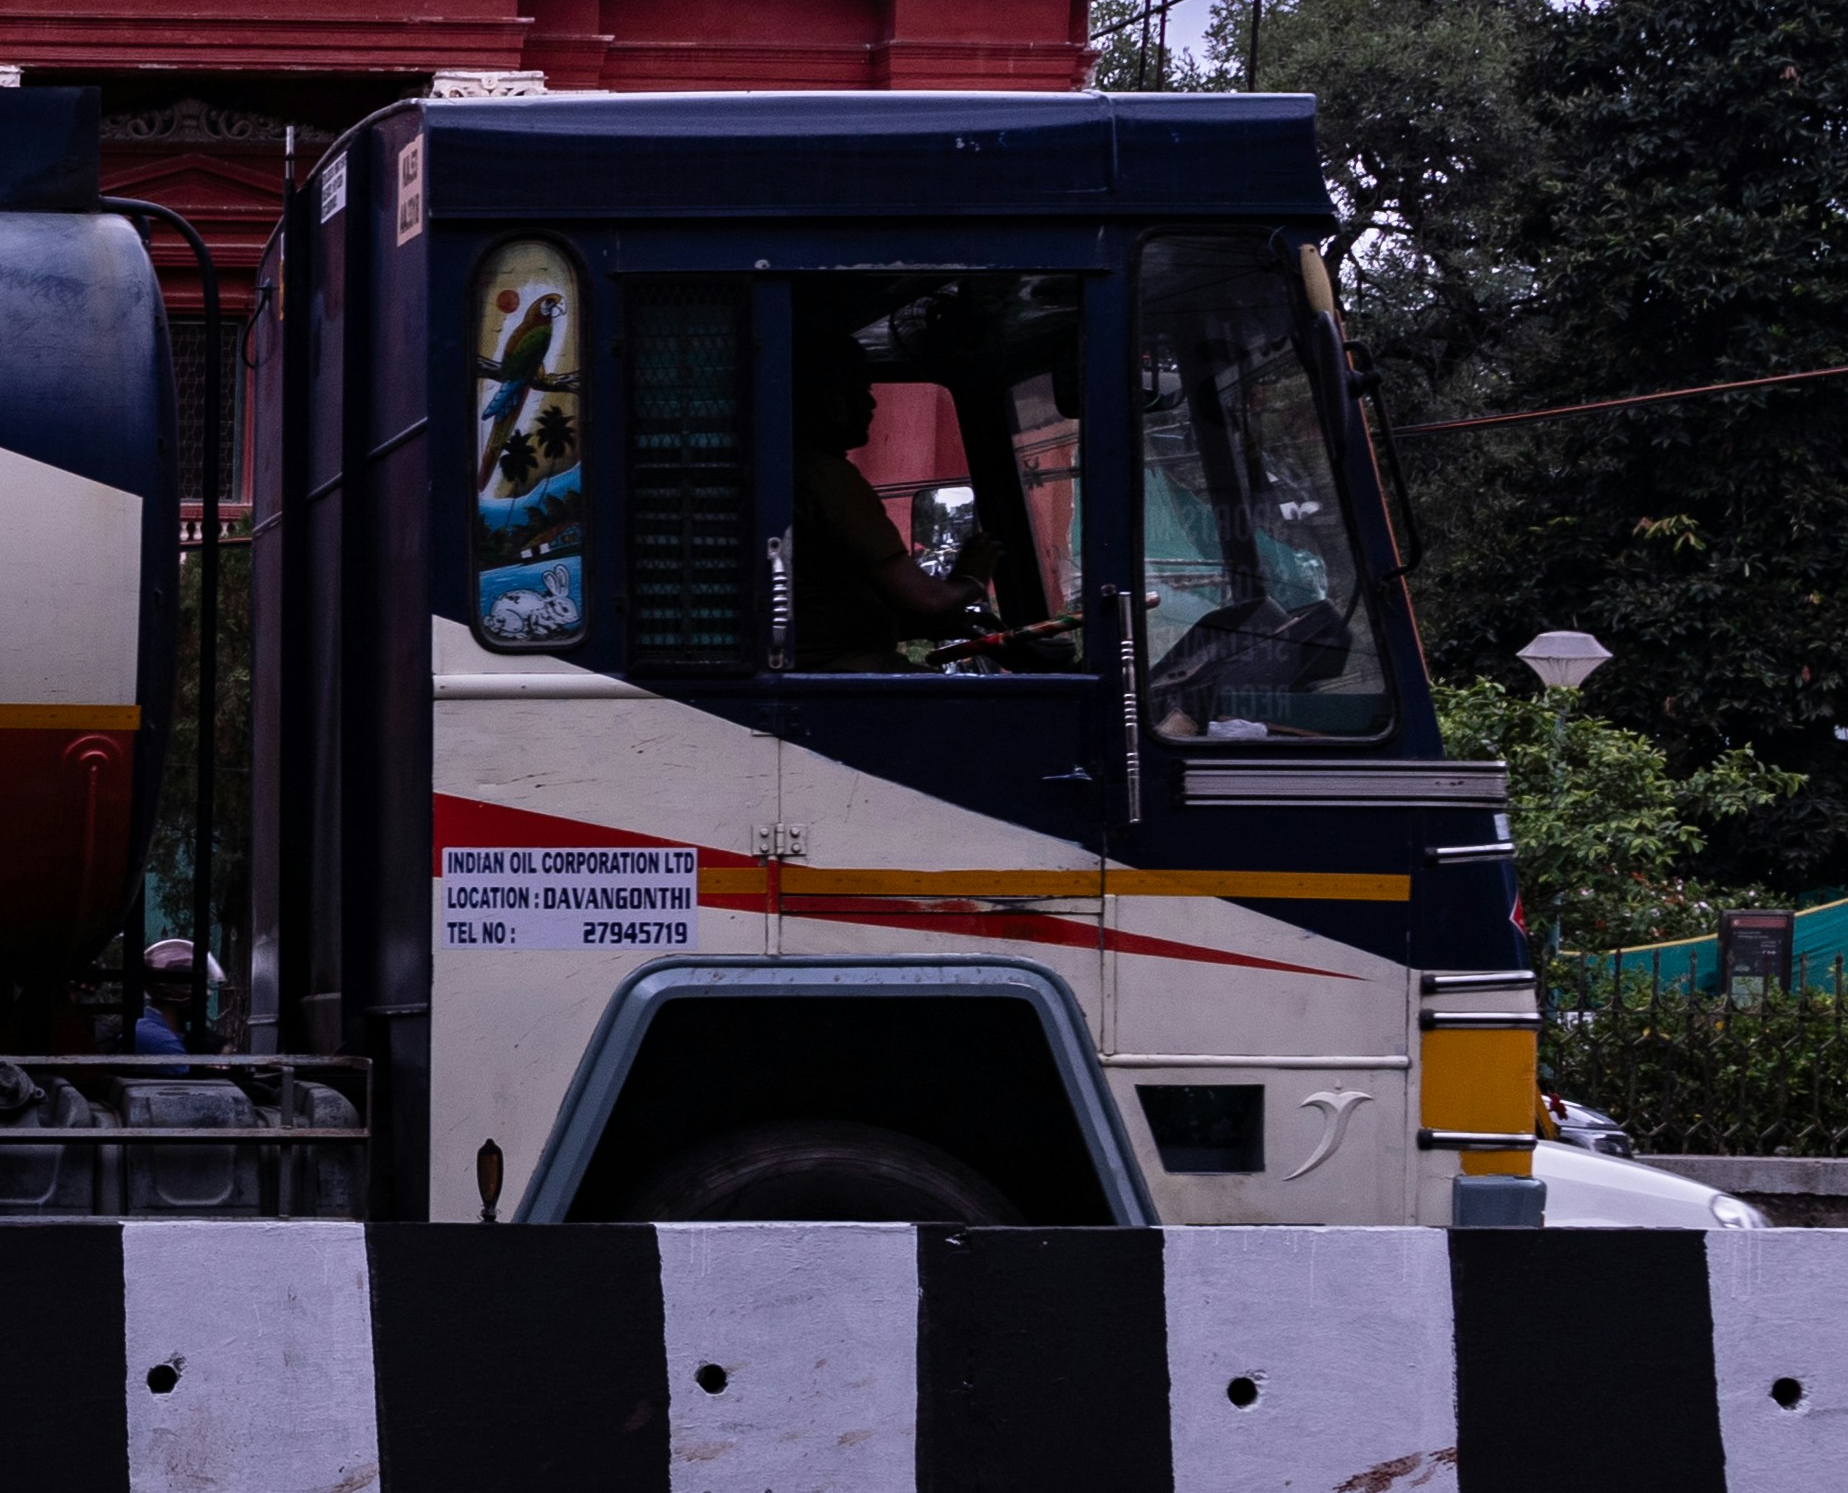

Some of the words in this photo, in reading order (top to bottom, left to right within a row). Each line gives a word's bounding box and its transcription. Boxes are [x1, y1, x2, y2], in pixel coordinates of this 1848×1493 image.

[447, 852, 505, 874] INDIAN
[509, 852, 537, 874] OIL
[541, 852, 660, 874] CORPORATION
[665, 852, 694, 874] LTD
[543, 887, 691, 909] DAVANGONTHI
[447, 922, 477, 944] TEL
[583, 922, 687, 944] 27945719
